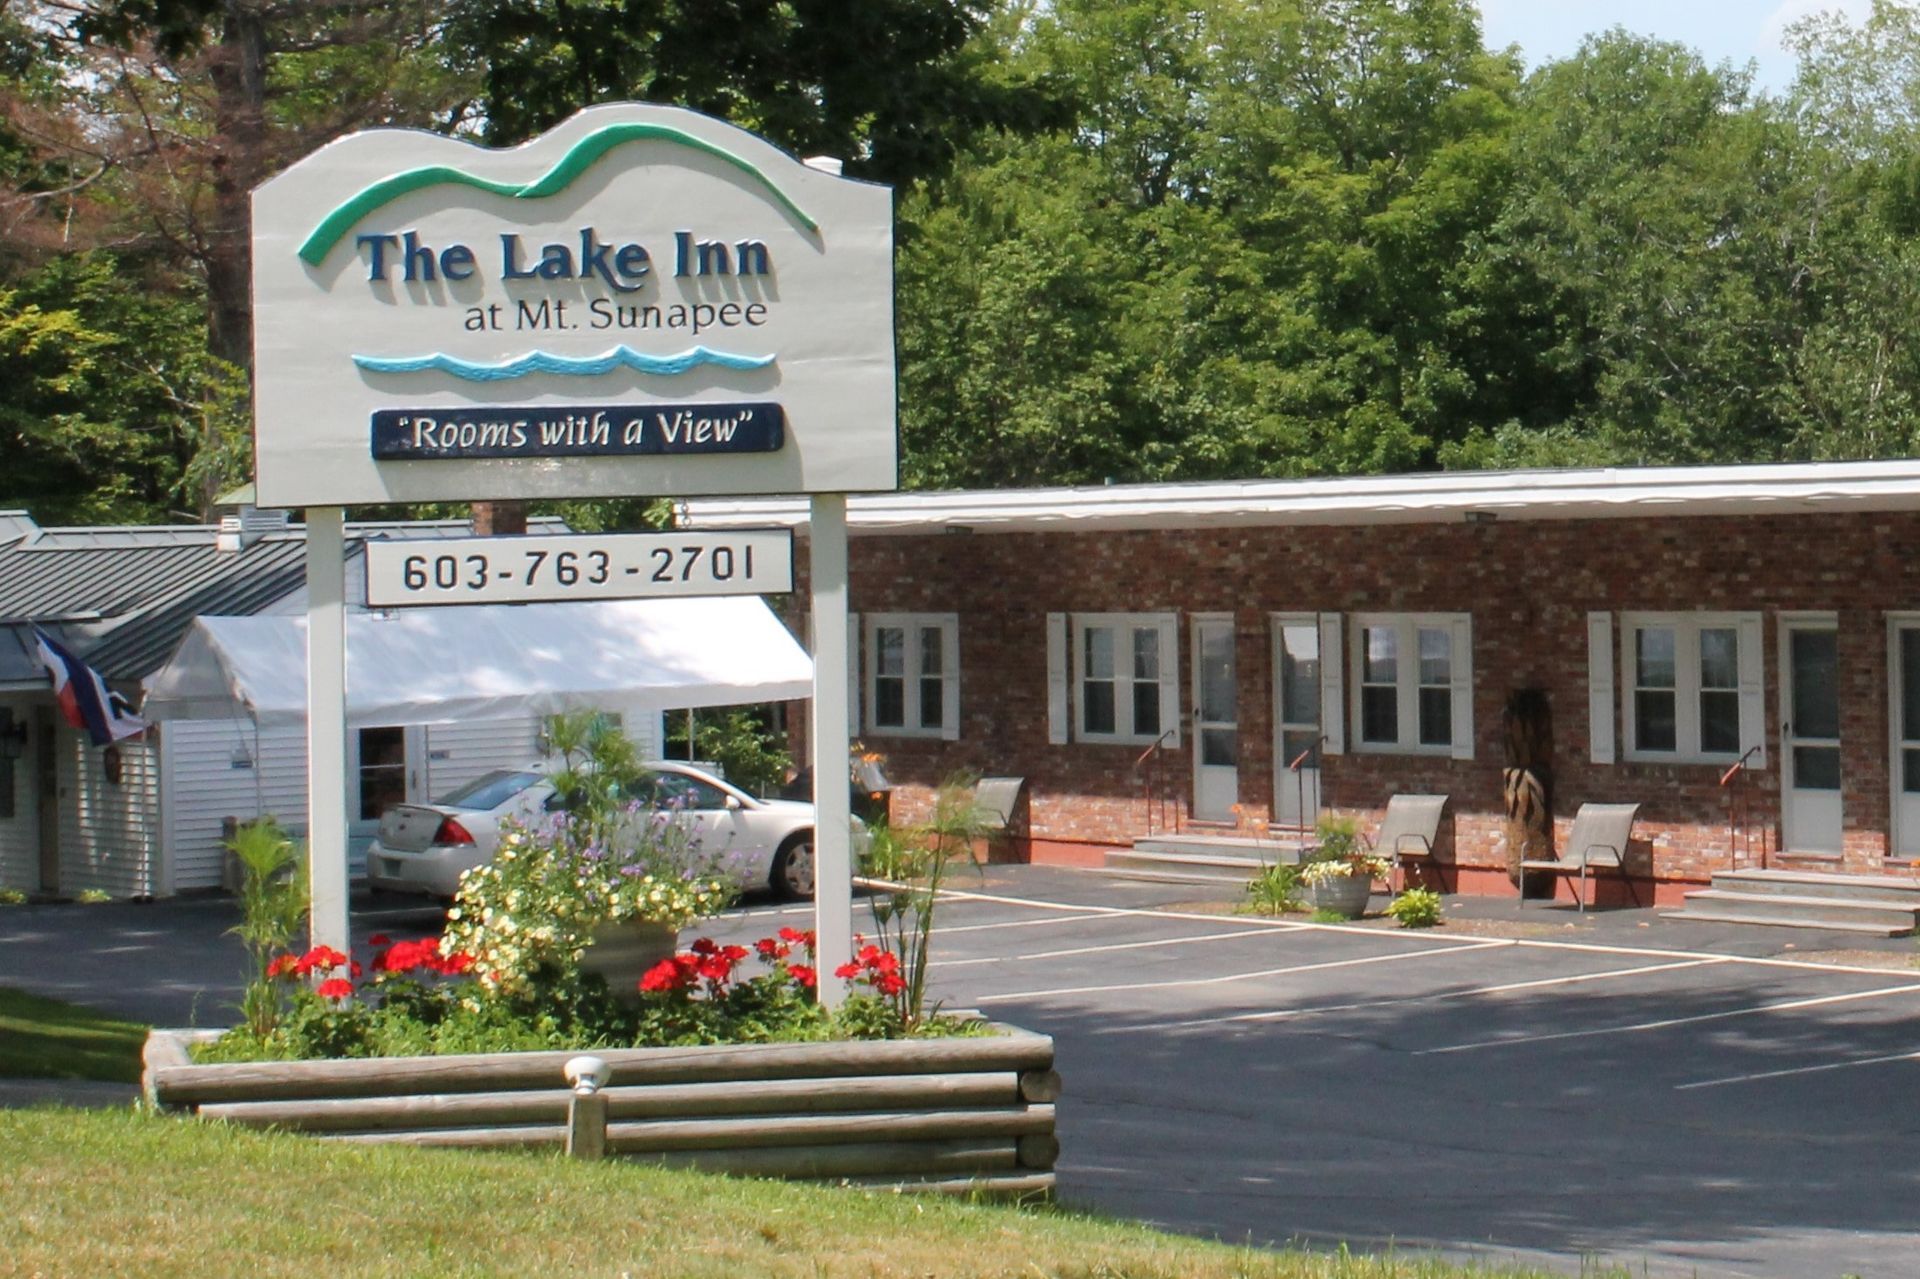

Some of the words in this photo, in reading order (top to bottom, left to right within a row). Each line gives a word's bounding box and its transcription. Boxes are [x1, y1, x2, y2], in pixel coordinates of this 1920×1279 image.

[357, 230, 475, 281] The
[500, 227, 649, 293] Lake
[673, 230, 769, 278] Inn
[464, 303, 503, 331] at
[516, 299, 577, 330] Mt.
[590, 298, 768, 336] Sunapee
[540, 411, 612, 446] with
[624, 418, 644, 445] a
[404, 545, 753, 590] 603-763-2701
